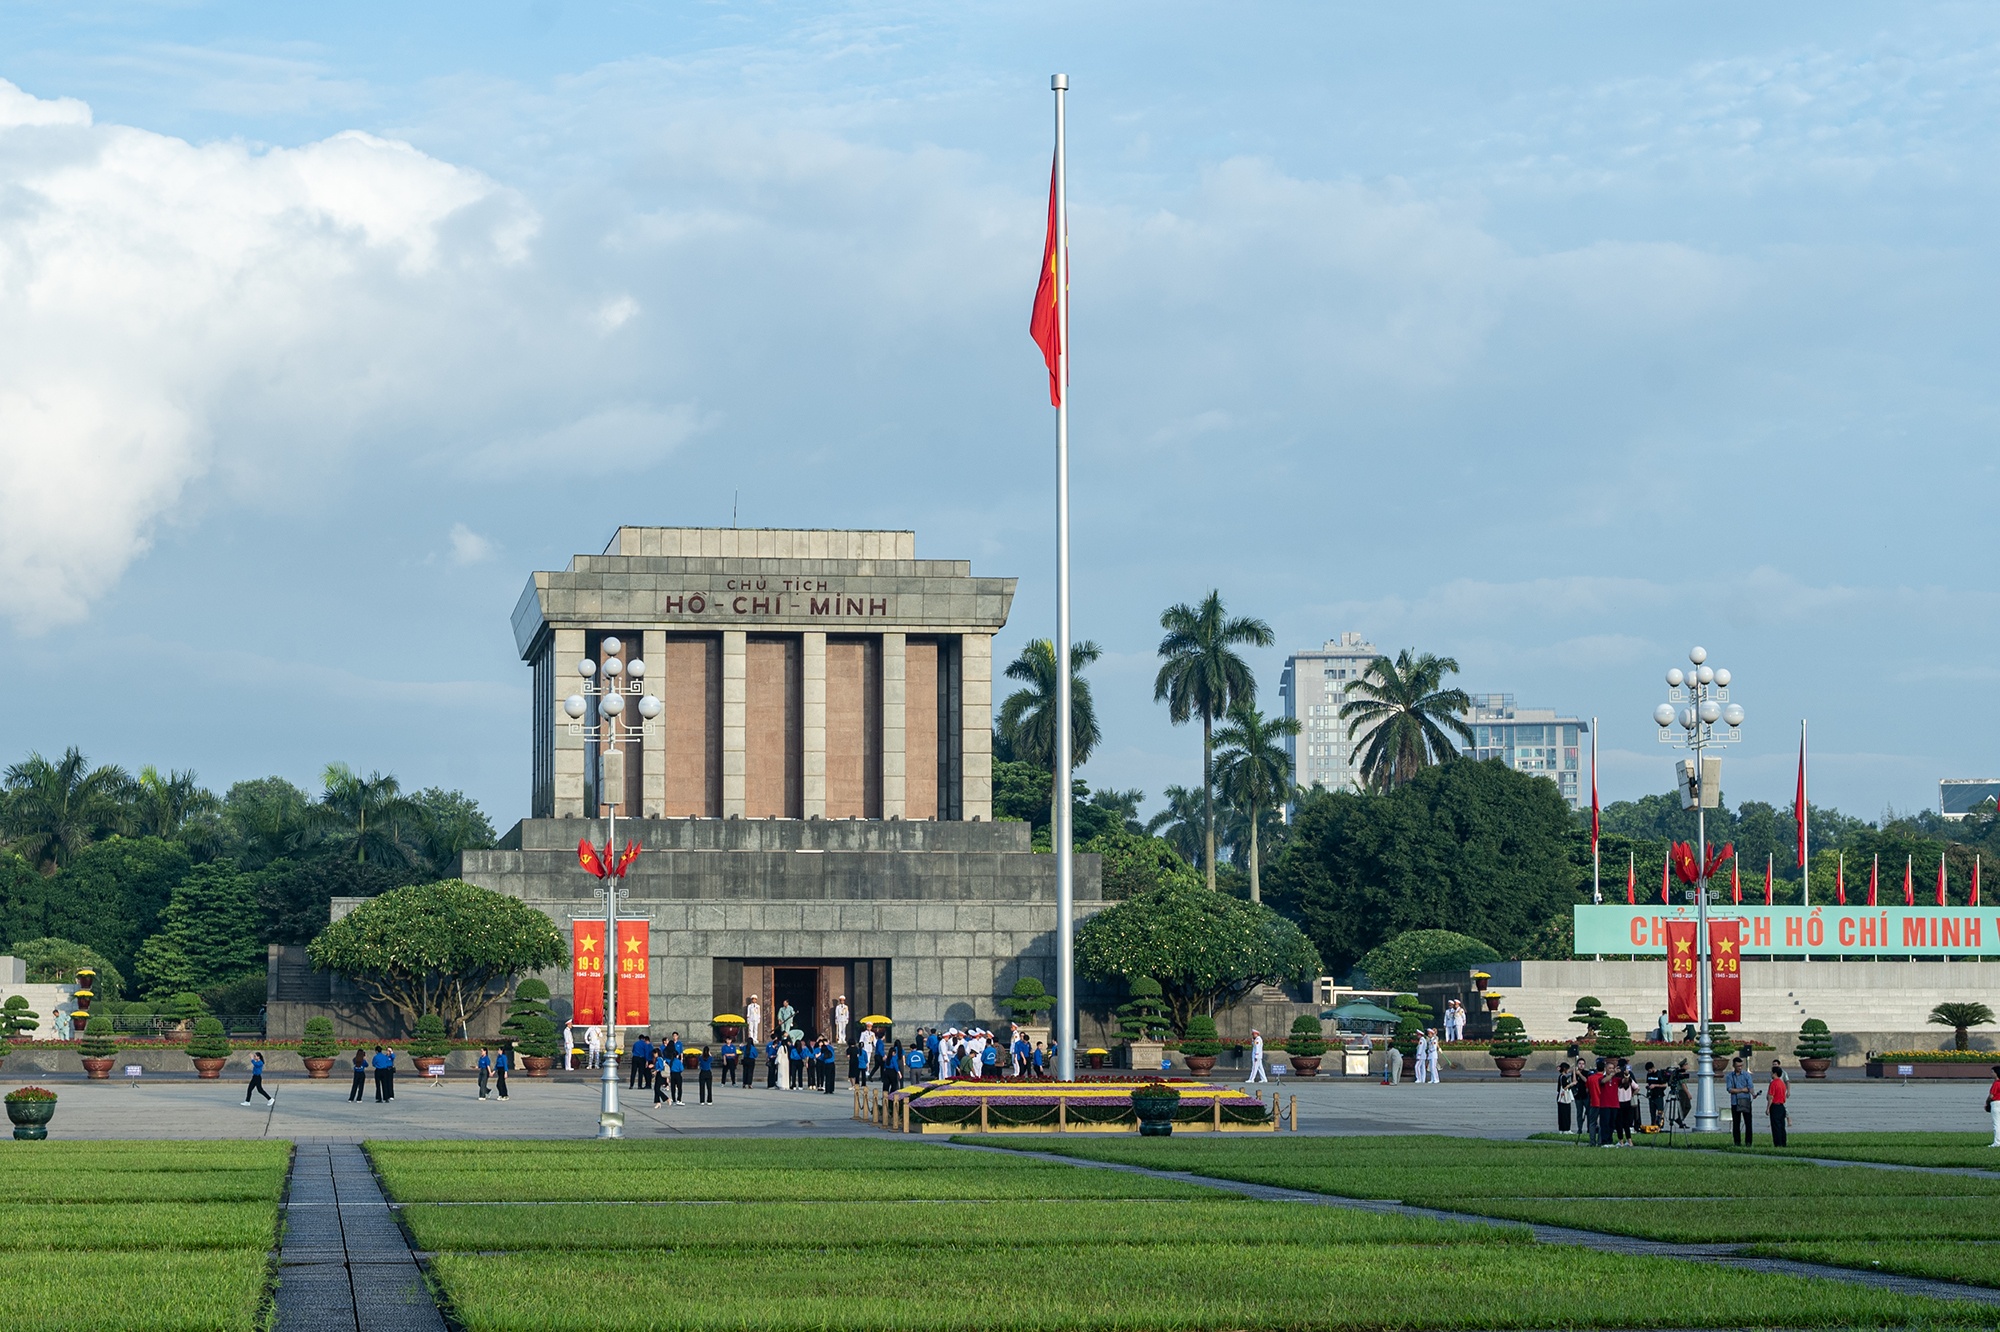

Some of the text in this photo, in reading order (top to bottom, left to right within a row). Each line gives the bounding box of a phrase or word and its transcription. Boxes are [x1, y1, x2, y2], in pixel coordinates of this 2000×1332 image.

[727, 575, 768, 591] CHỦ
[666, 591, 708, 614] HỒ
[732, 592, 786, 615] CHÍ
[1630, 907, 1689, 947] CH
[1786, 906, 1824, 947] HỒ
[1838, 910, 1888, 947] CHÍ
[1903, 917, 1981, 947] MINH
[578, 956, 600, 971] 19-8
[622, 958, 645, 972] 19-8
[1673, 958, 1692, 972] 2-9
[1716, 958, 1737, 972] 2-9
